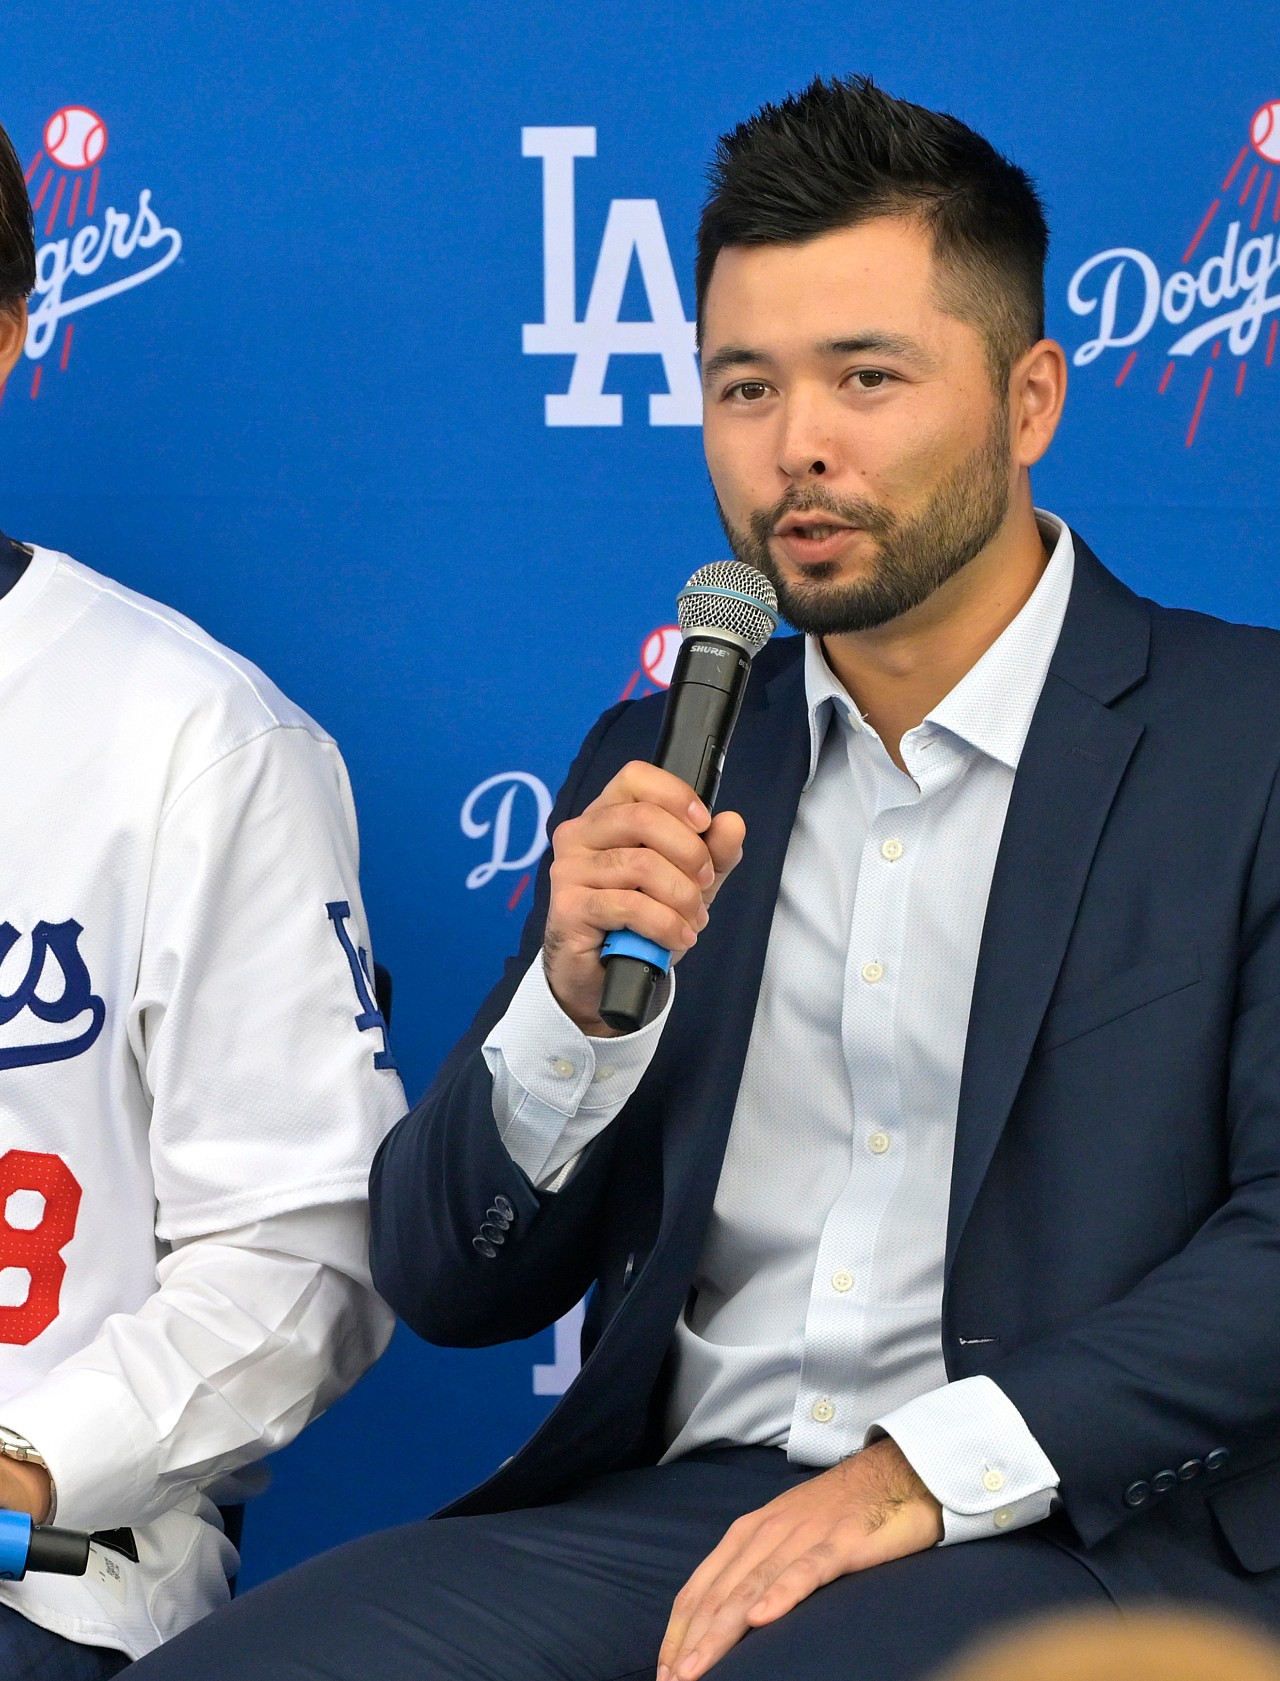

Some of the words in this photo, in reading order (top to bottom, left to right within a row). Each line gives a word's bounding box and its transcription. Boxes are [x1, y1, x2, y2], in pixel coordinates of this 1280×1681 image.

[522, 126, 703, 427] LA
[1067, 220, 1280, 367] Dodg
[689, 644, 727, 658] SHURE
[325, 900, 397, 1070] L
